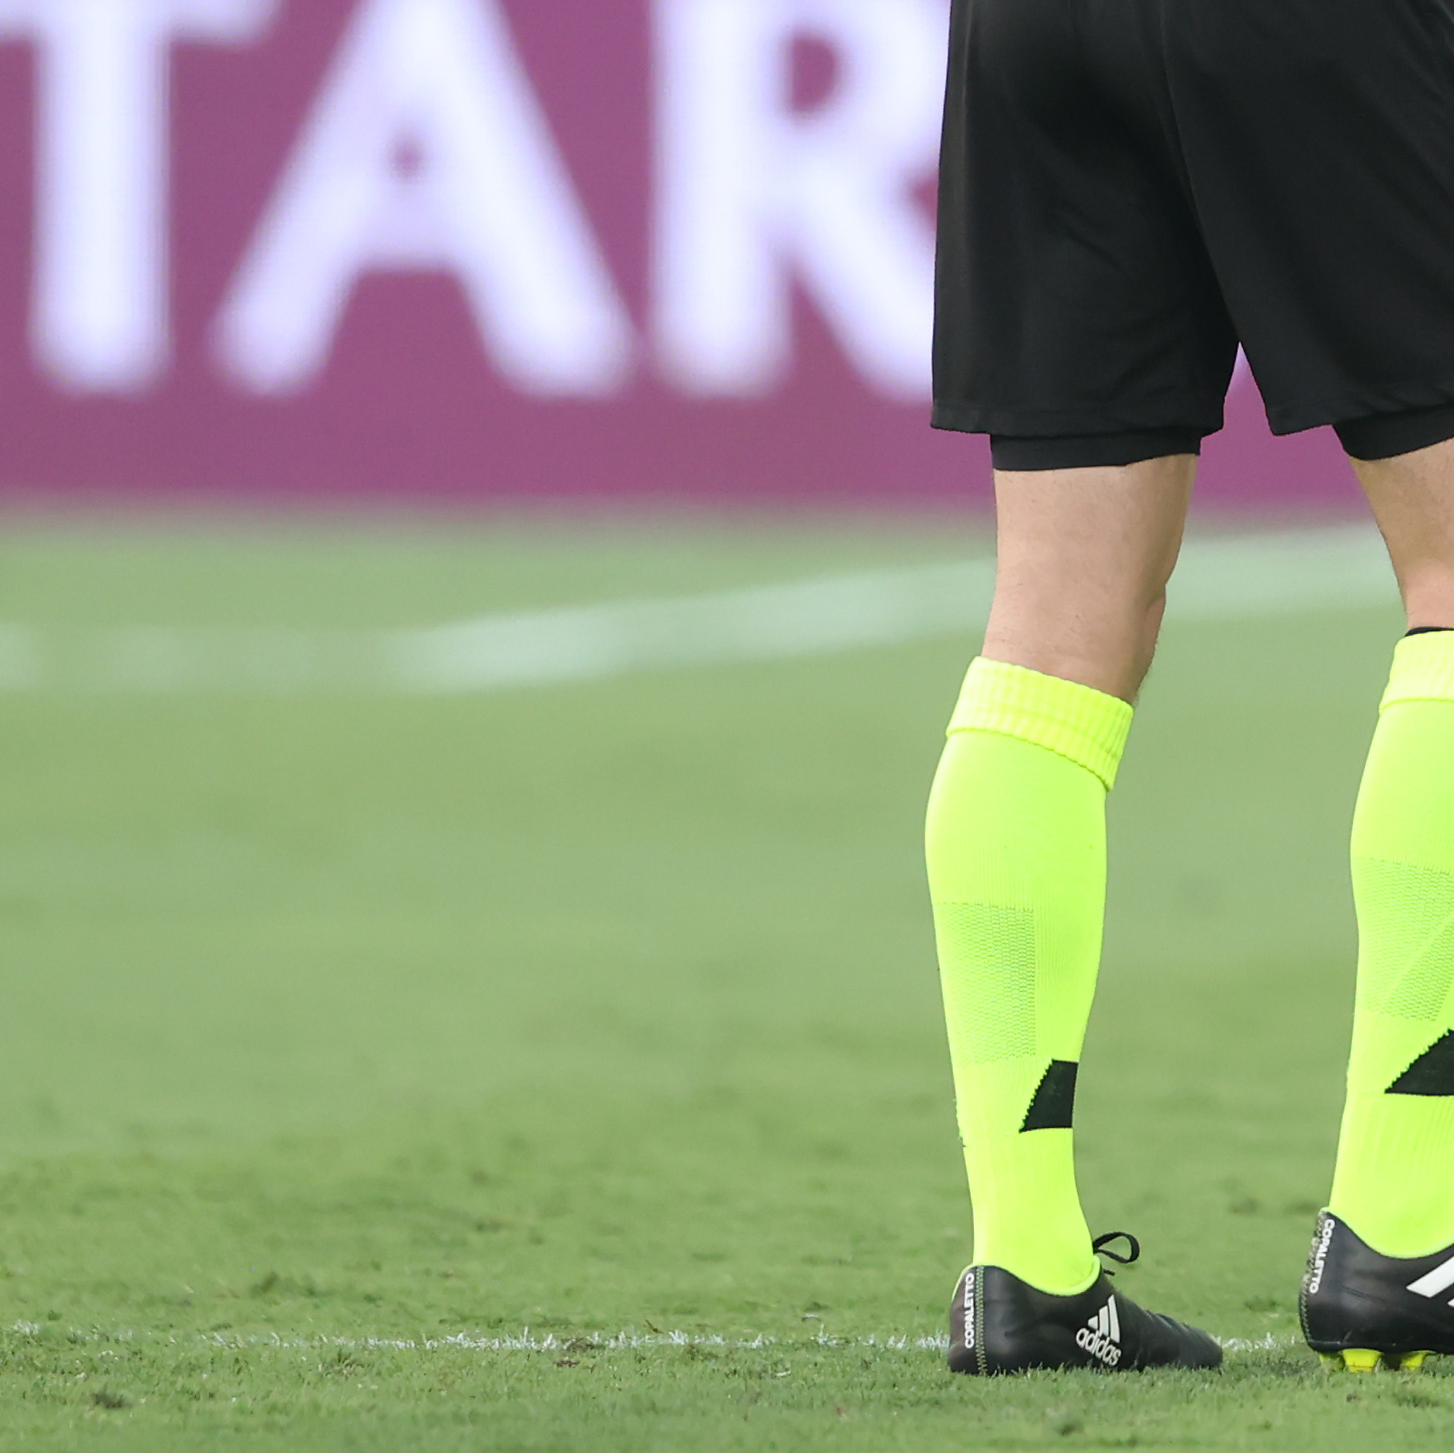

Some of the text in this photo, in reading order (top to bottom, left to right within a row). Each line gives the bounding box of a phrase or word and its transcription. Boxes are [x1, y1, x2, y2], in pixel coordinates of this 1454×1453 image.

[1308, 1218, 1336, 1294] COPALETTO
[964, 1272, 975, 1349] COPALETTO
[1075, 1326, 1122, 1367] adidas
